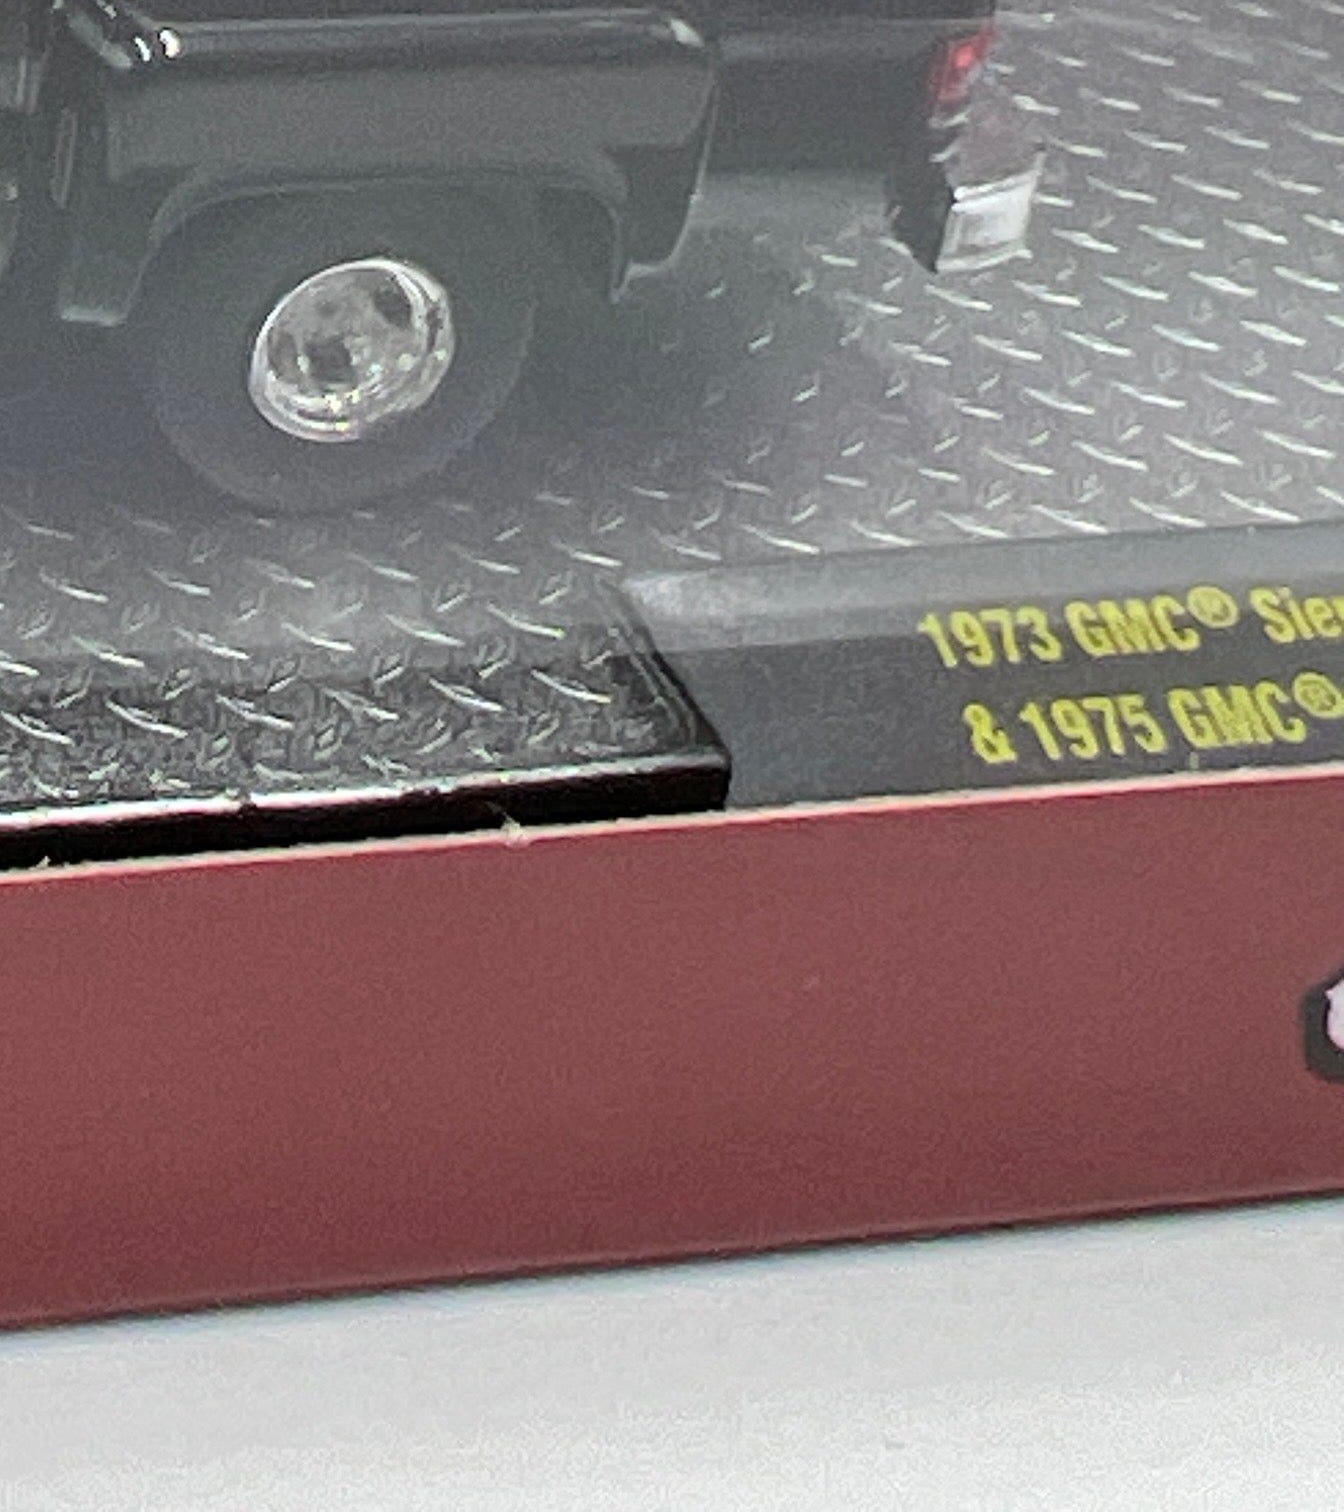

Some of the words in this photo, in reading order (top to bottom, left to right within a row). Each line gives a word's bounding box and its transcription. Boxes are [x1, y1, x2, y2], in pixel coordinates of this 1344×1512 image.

[918, 606, 1063, 668] 1973
[962, 702, 1018, 765] &
[1019, 694, 1169, 762] 1975
